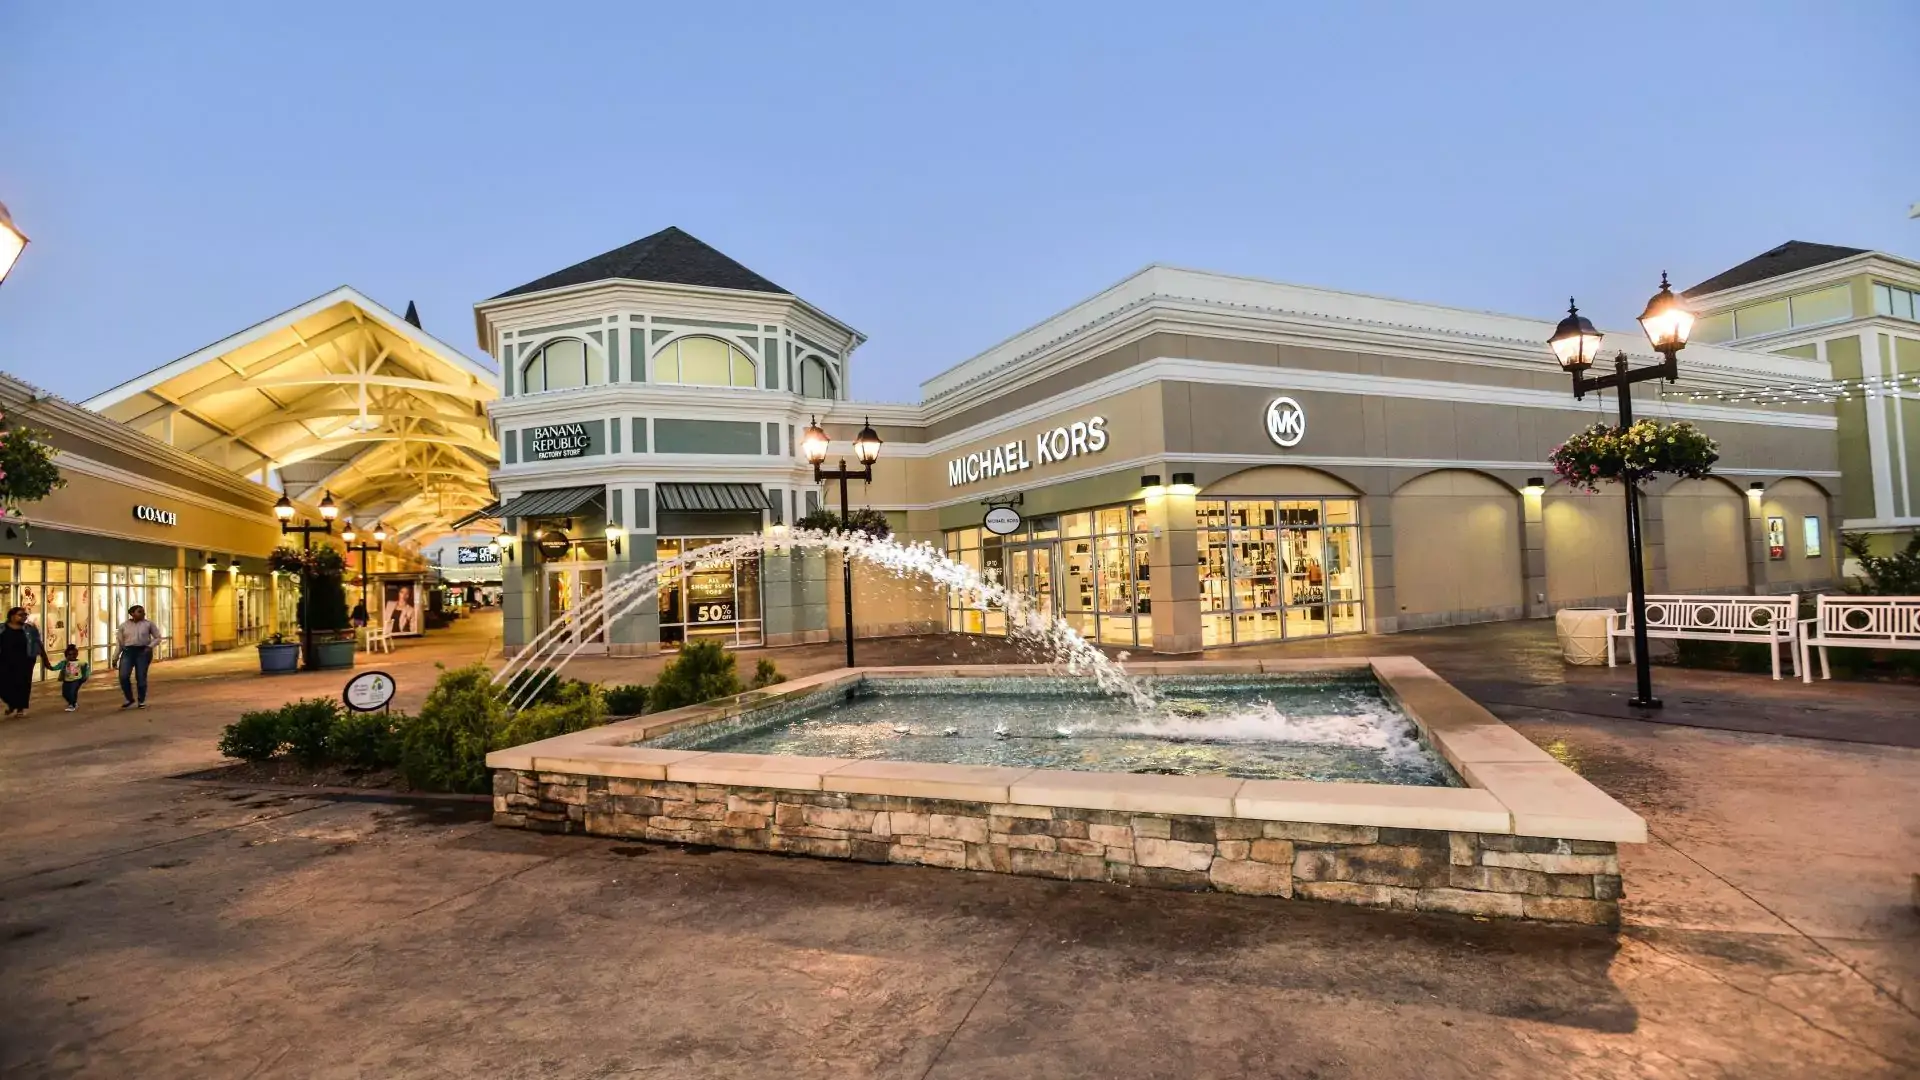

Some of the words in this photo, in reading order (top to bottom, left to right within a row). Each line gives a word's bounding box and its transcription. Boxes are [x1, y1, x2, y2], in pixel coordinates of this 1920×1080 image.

[534, 423, 583, 439] BANANA
[532, 435, 587, 452] REPUBLIC
[948, 439, 1031, 487] MICHAEL
[1036, 416, 1107, 465] KORS
[538, 450, 562, 459] FACTORY
[562, 448, 581, 457] STORE
[136, 505, 177, 526] COACH
